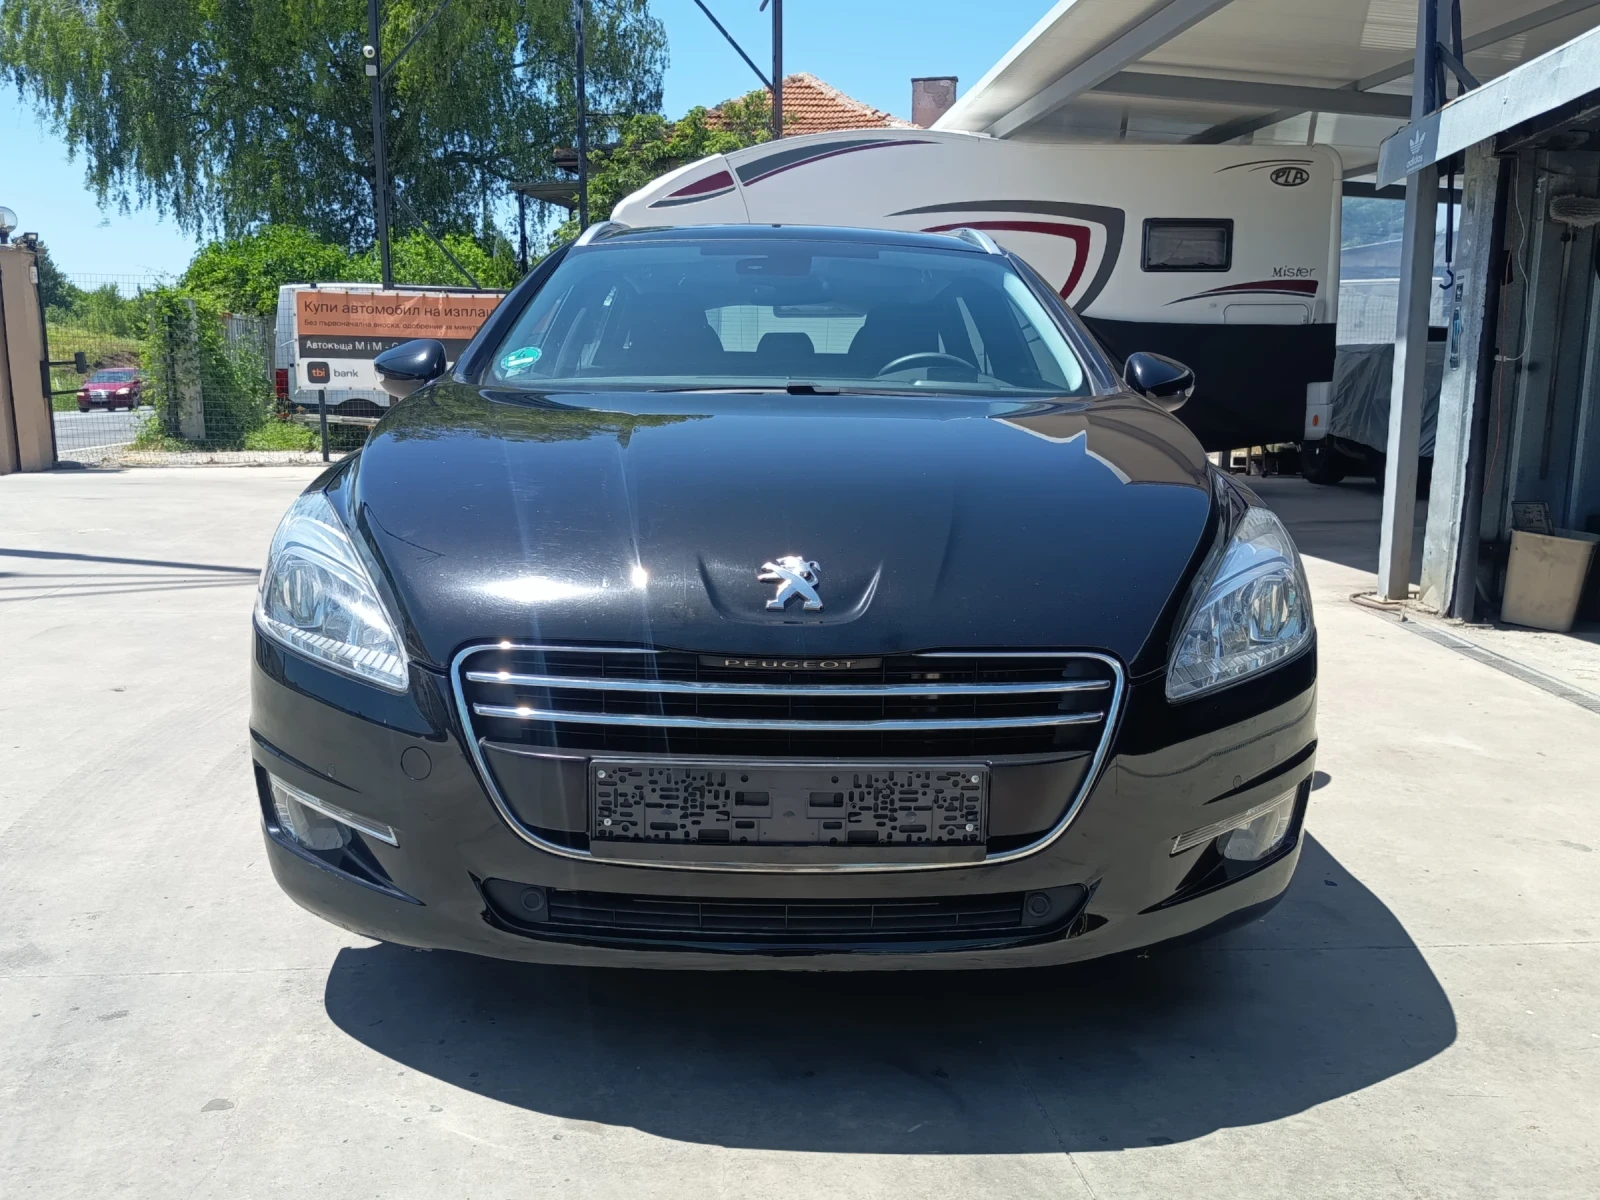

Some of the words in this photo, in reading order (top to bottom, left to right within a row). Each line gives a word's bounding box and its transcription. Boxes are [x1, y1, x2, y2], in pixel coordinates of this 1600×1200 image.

[1273, 169, 1307, 184] PLA
[1270, 265, 1316, 278] Mister
[304, 300, 338, 314] Купи
[342, 303, 420, 316] автомобил
[424, 307, 440, 317] на
[319, 320, 372, 328] първоначална
[402, 322, 443, 330] одобрение
[306, 340, 353, 351] Автокъща
[311, 368, 326, 377] tbi
[333, 368, 359, 378] bank
[724, 659, 857, 668] PEUGEOT
